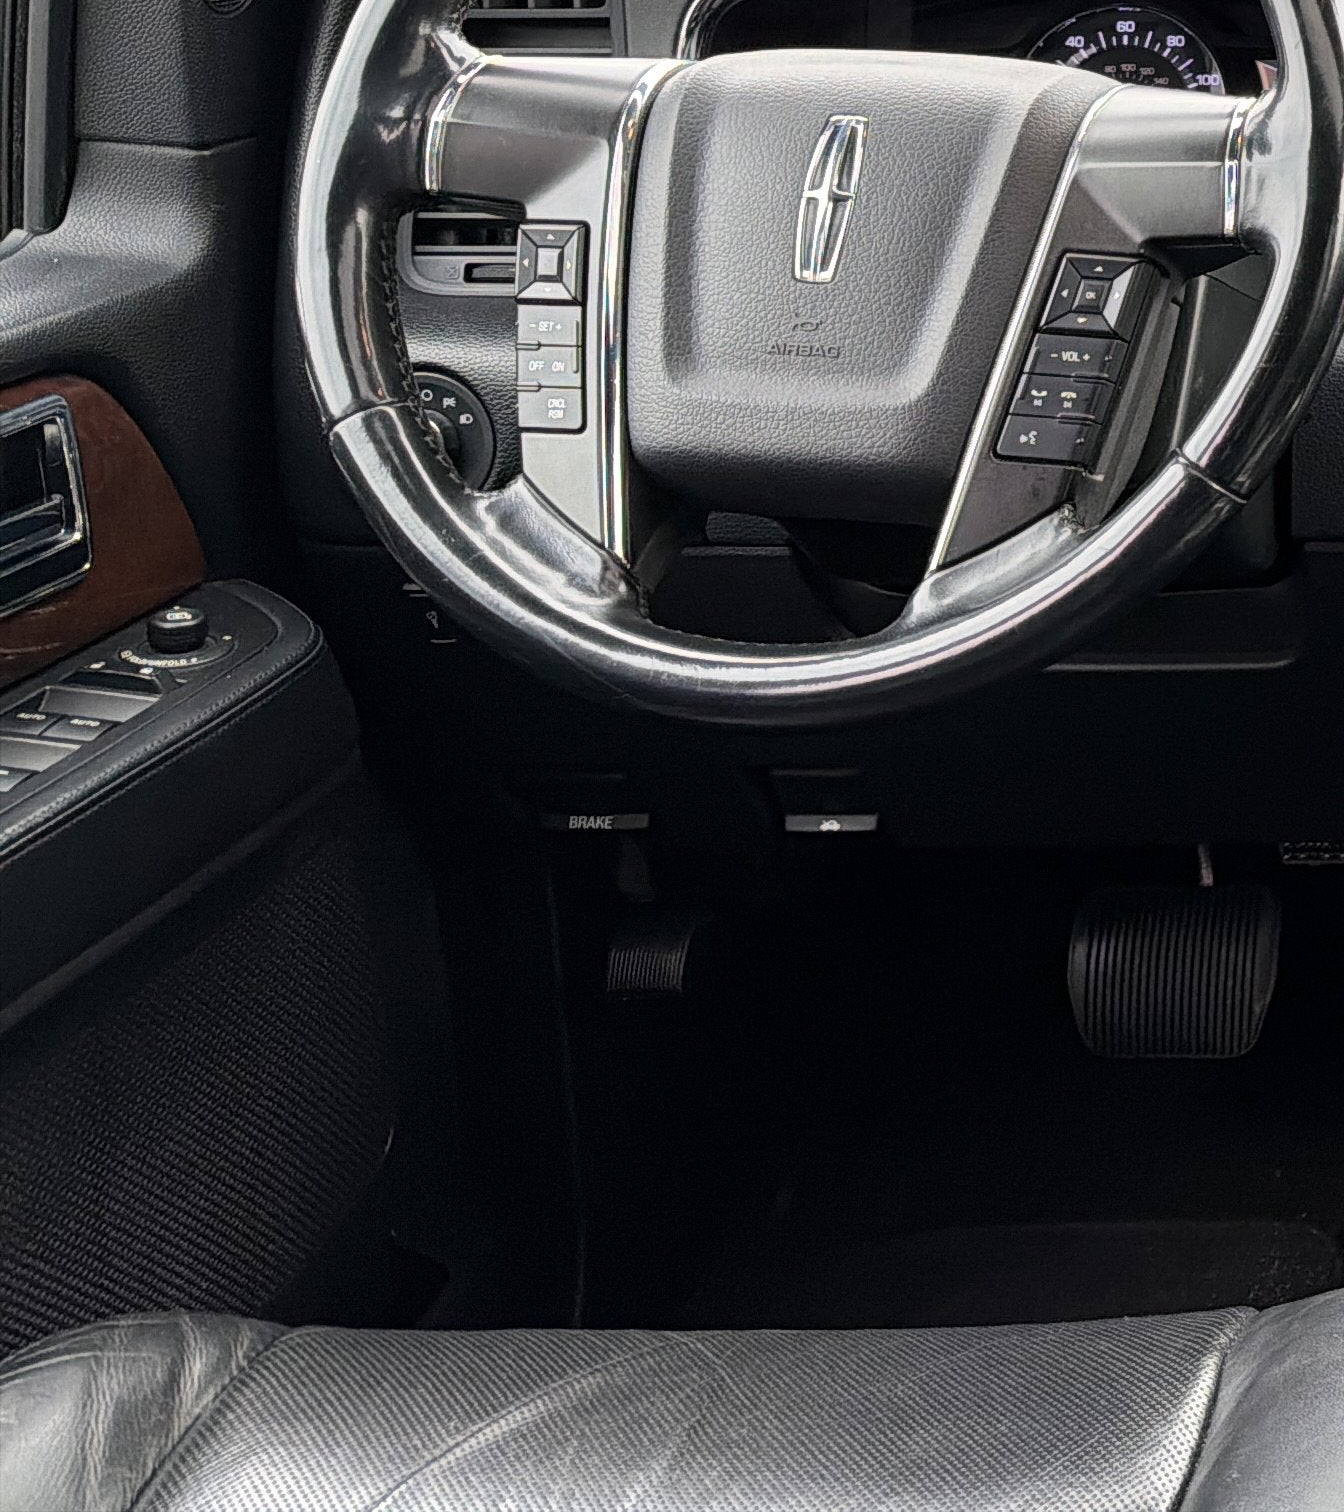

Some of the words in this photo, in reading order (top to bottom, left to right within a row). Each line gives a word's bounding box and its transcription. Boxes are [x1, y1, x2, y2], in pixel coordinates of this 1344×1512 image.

[1116, 20, 1136, 33] 60
[1065, 36, 1085, 48] 40
[1166, 35, 1185, 48] 80
[1195, 74, 1220, 86] 100
[1085, 291, 1097, 300] OK
[538, 321, 555, 332] SET
[765, 341, 841, 358] AIRBAG
[1061, 351, 1081, 362] VOL
[529, 361, 545, 372] OFF
[552, 362, 565, 372] ON
[547, 398, 567, 408] CNCL
[548, 410, 564, 419] RSM
[16, 712, 47, 721] AUTO
[69, 718, 100, 727] AUTO
[568, 815, 614, 830] BRAKE
